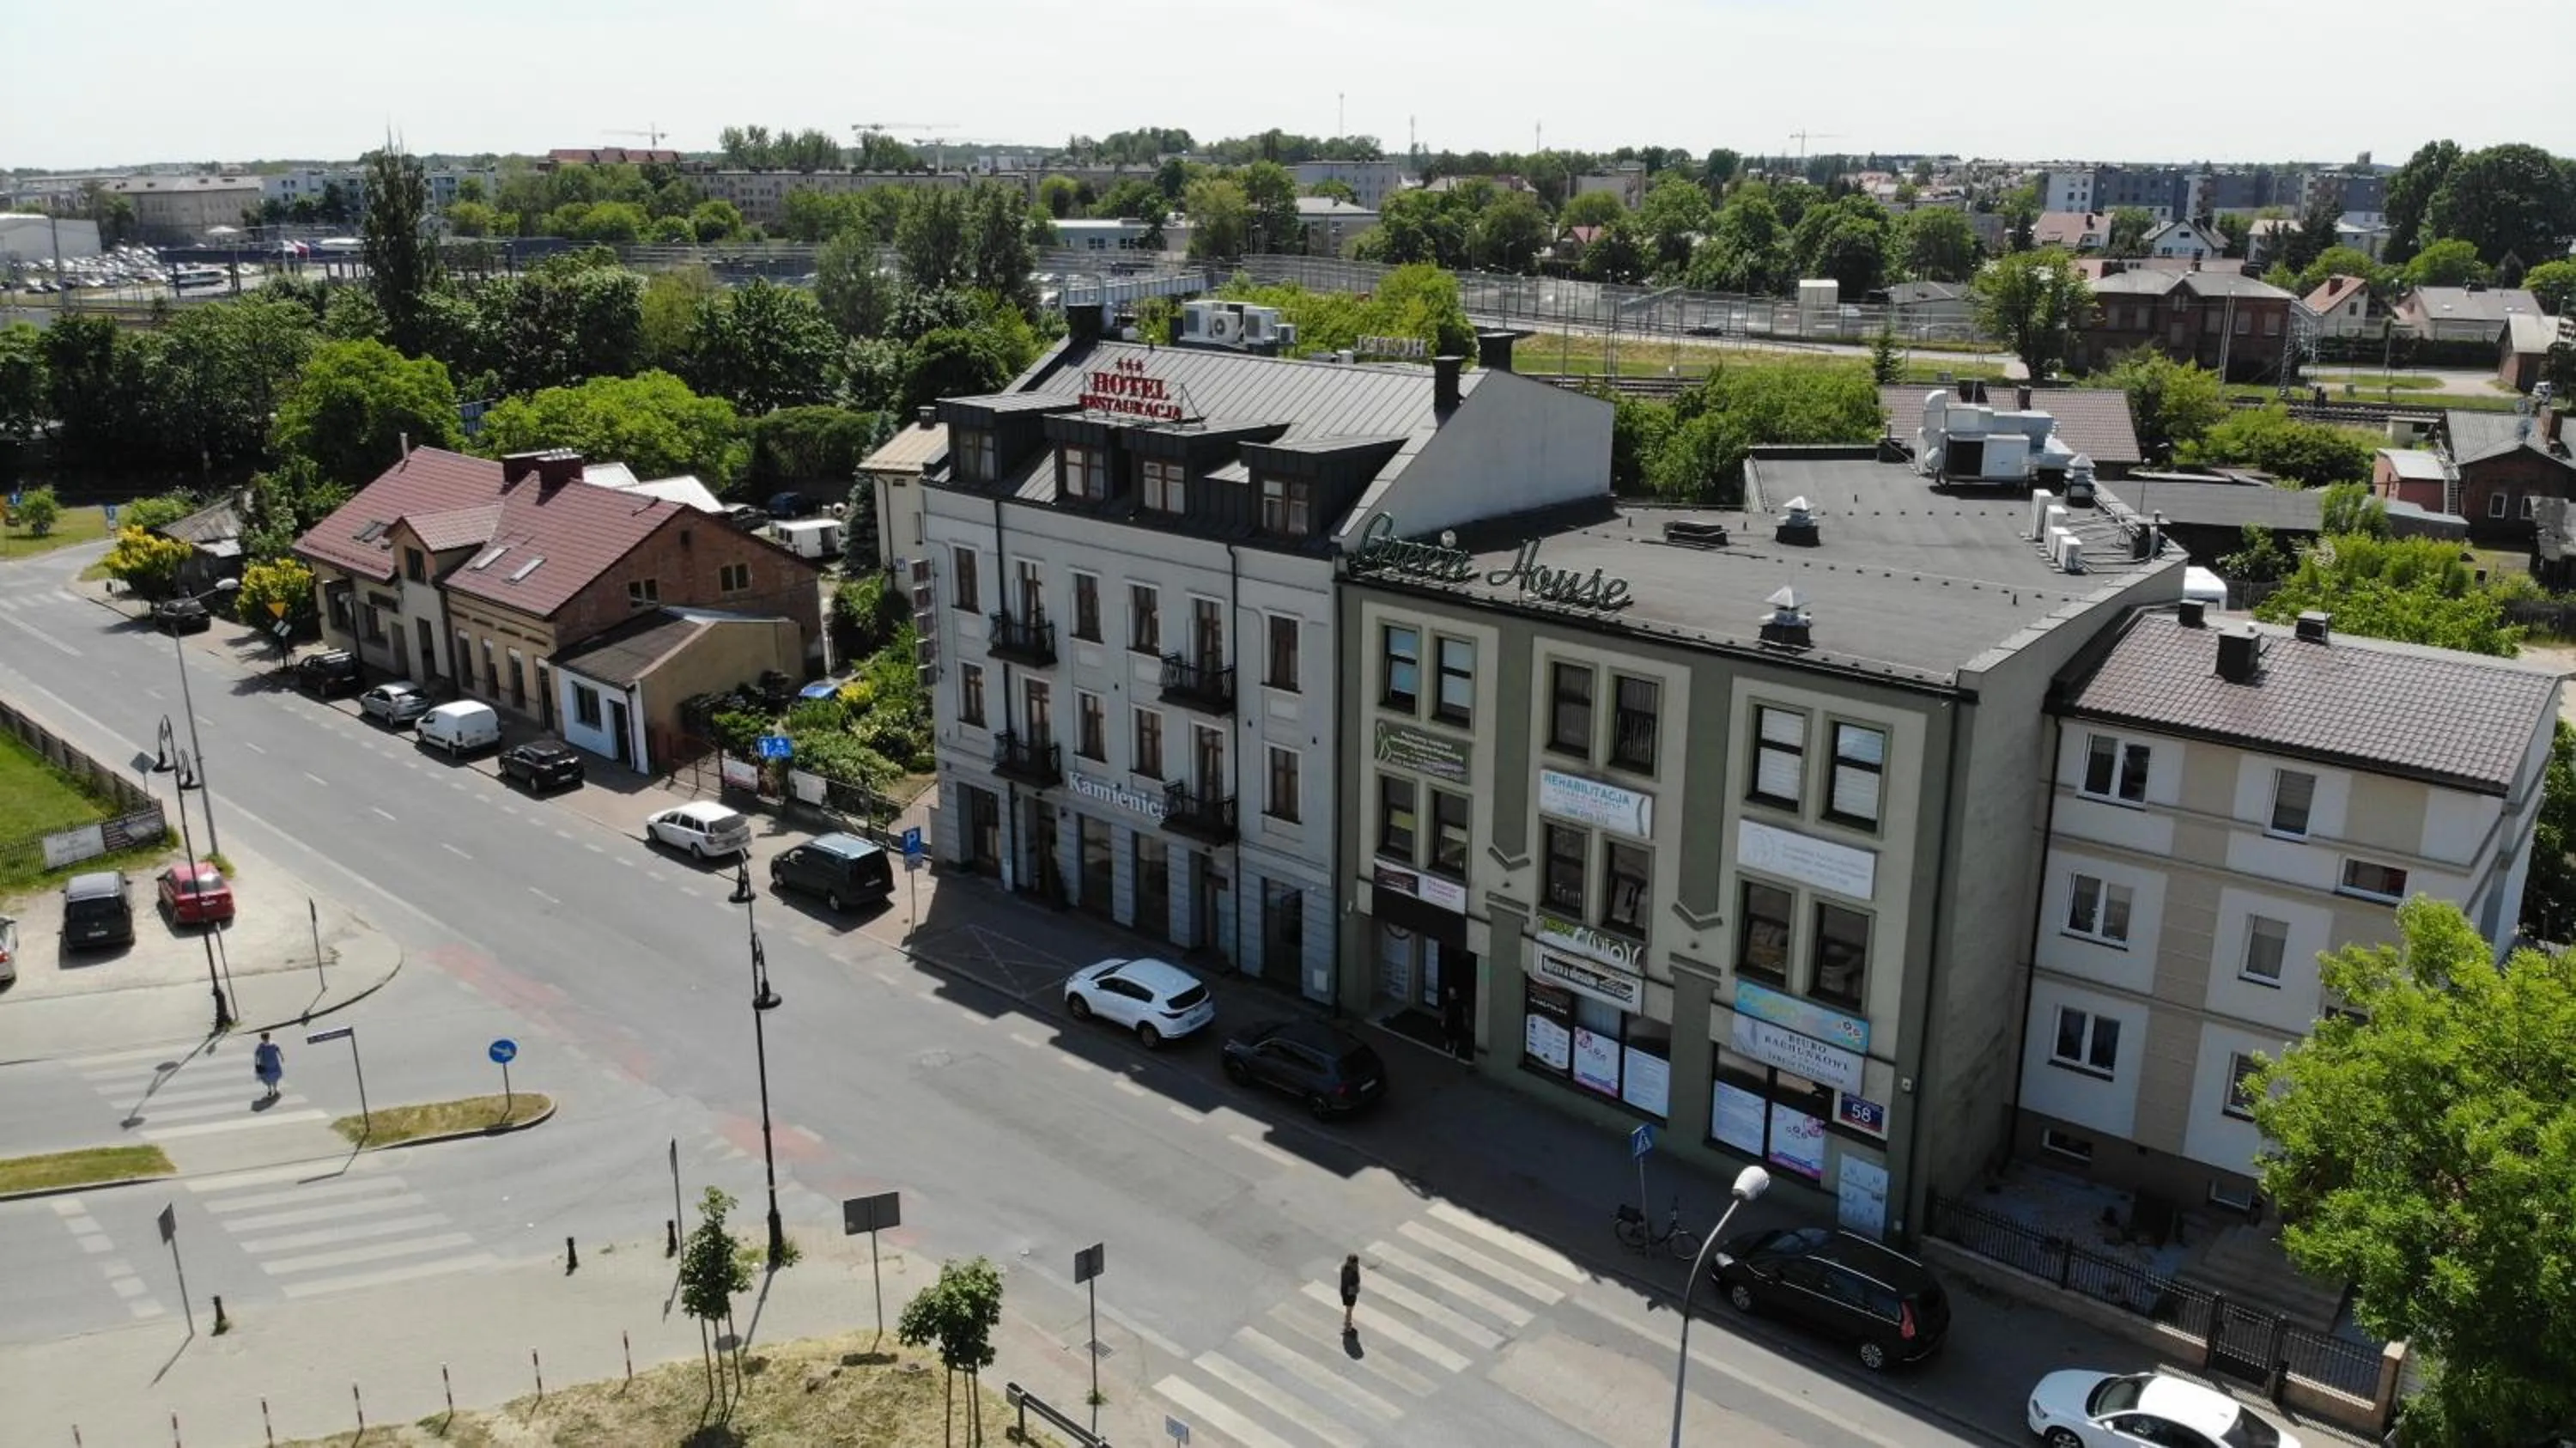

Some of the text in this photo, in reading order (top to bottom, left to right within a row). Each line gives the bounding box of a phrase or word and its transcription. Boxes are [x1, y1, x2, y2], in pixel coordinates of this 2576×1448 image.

[1091, 372, 1170, 400] HOTEL
[1486, 537, 1633, 611] House
[1543, 773, 1630, 806] REHABILITACJA
[907, 830, 918, 849] P
[1789, 1033, 1826, 1054] BIURO
[1851, 1103, 1871, 1123] 58
